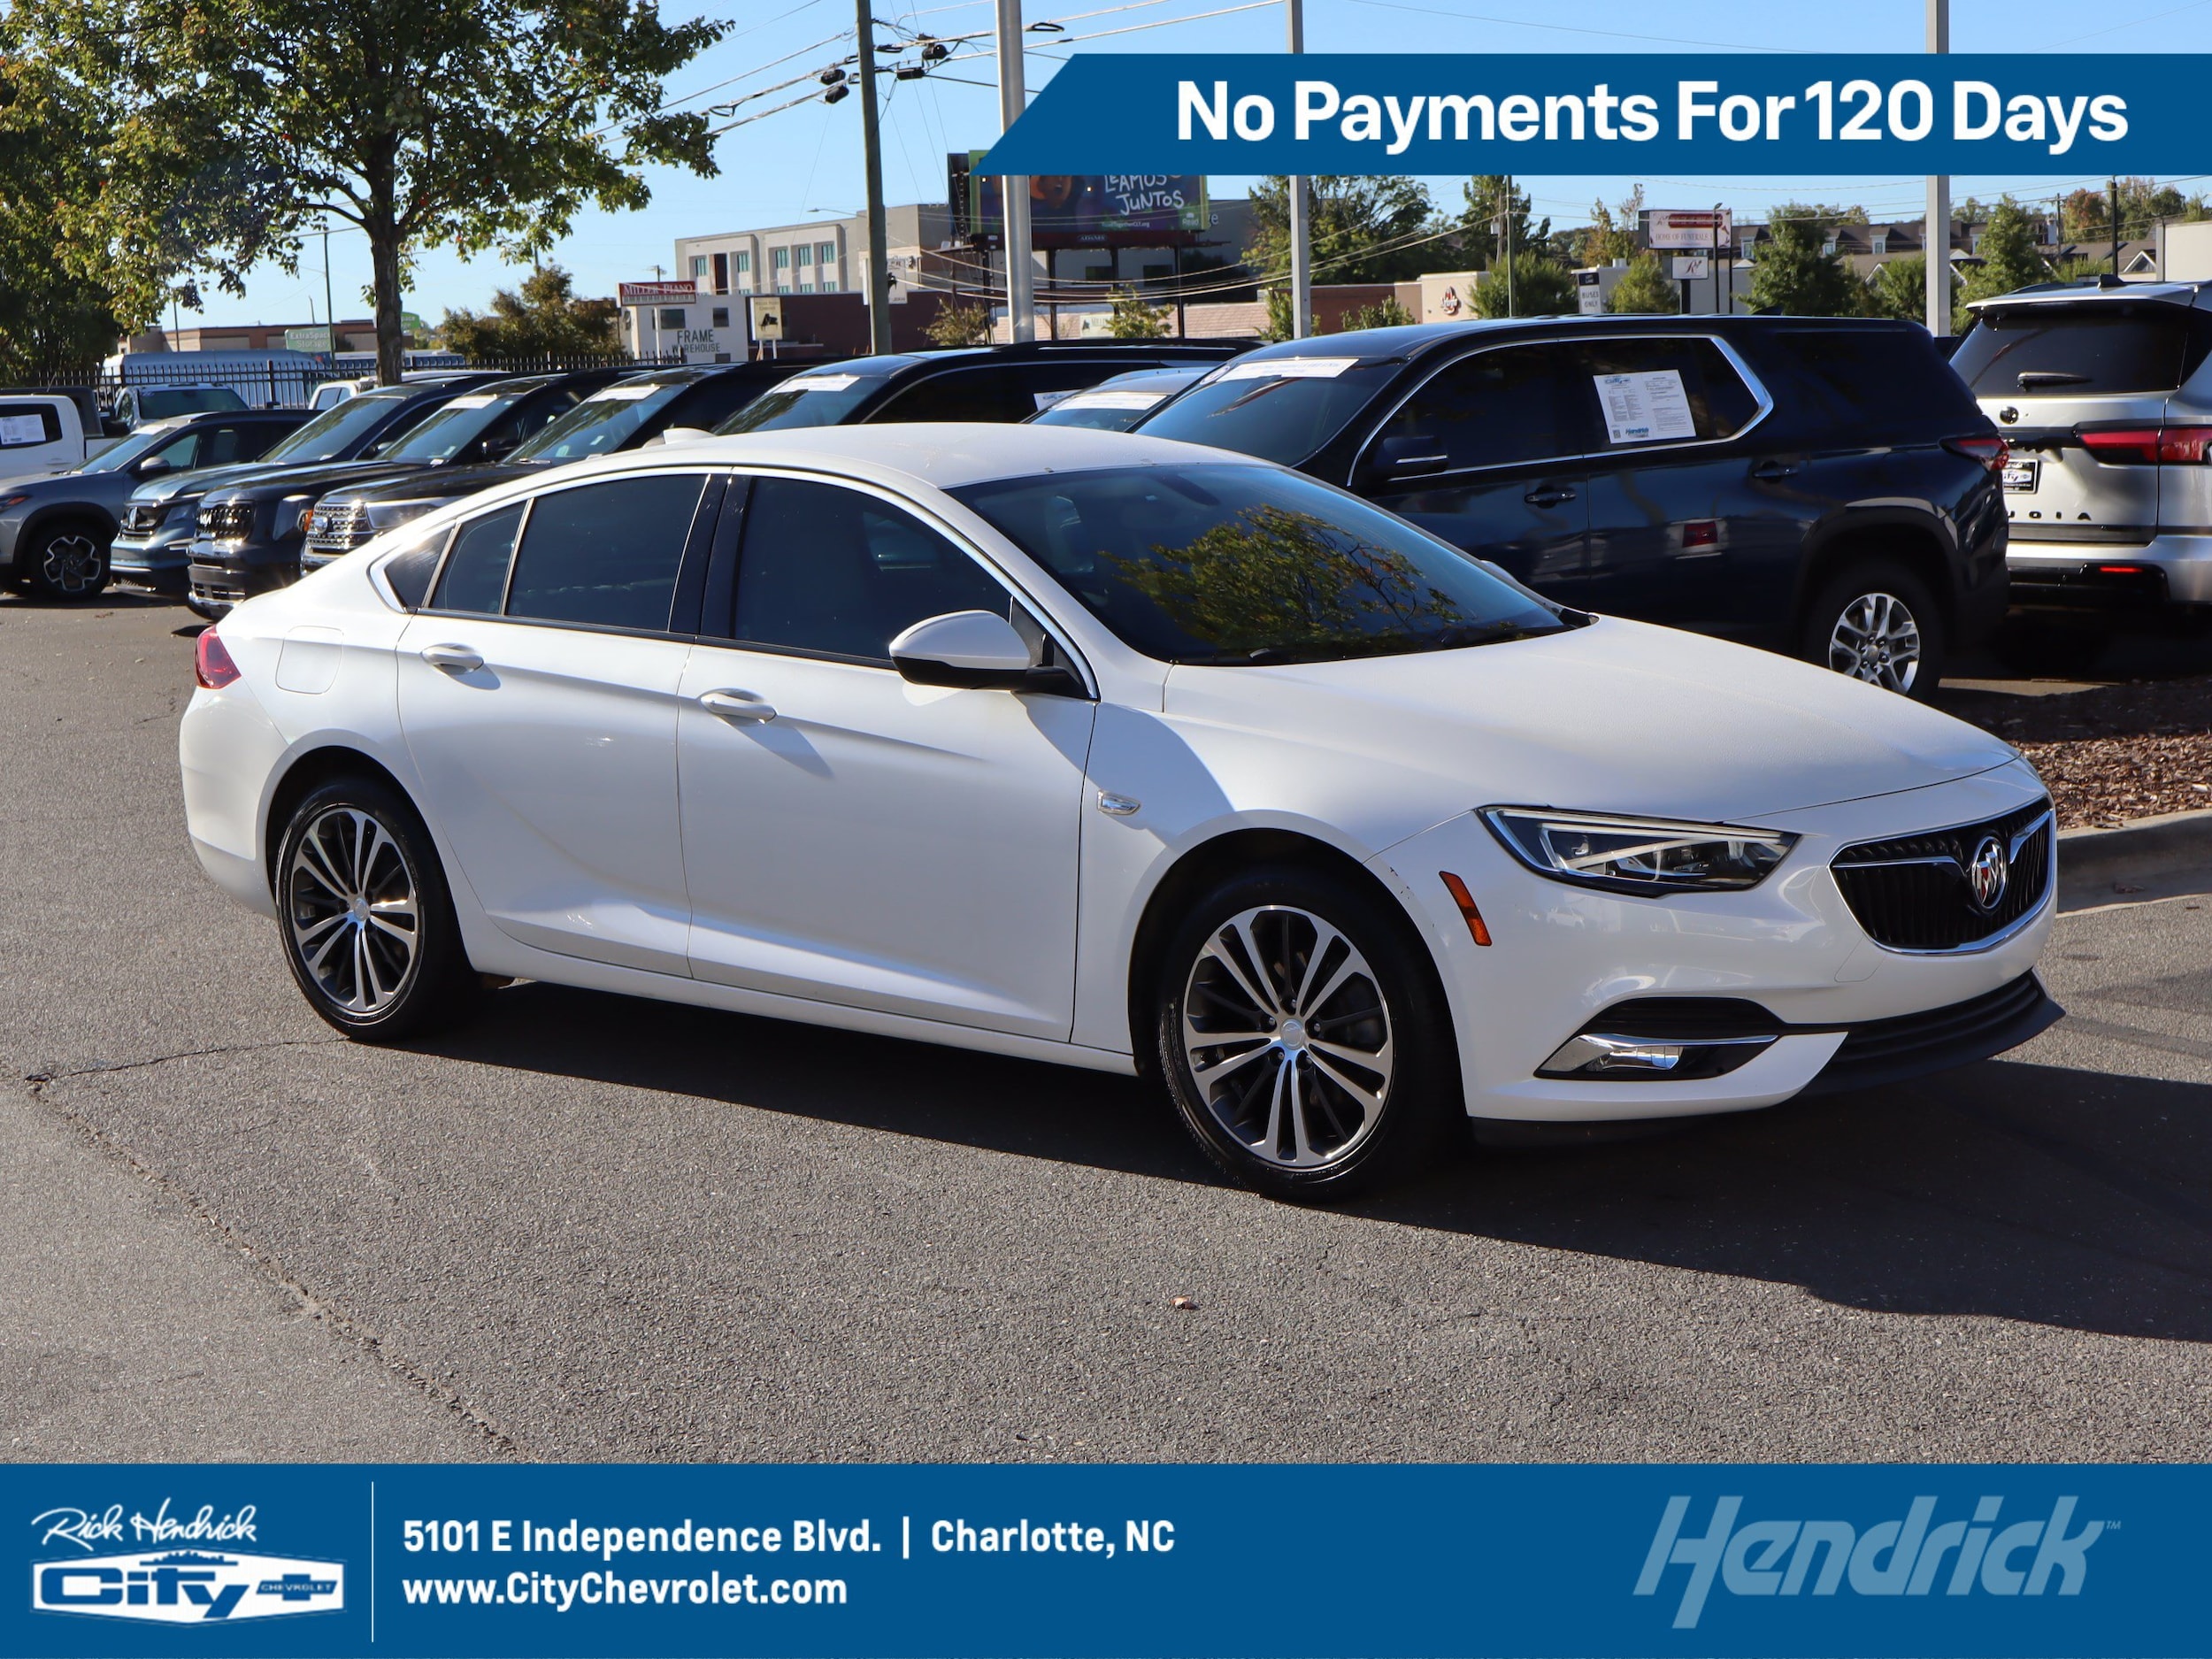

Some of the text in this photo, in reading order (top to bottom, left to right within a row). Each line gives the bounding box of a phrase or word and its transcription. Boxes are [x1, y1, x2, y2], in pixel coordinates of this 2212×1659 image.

[623, 283, 693, 295] MILLER PIANO
[677, 329, 714, 344] FRAME
